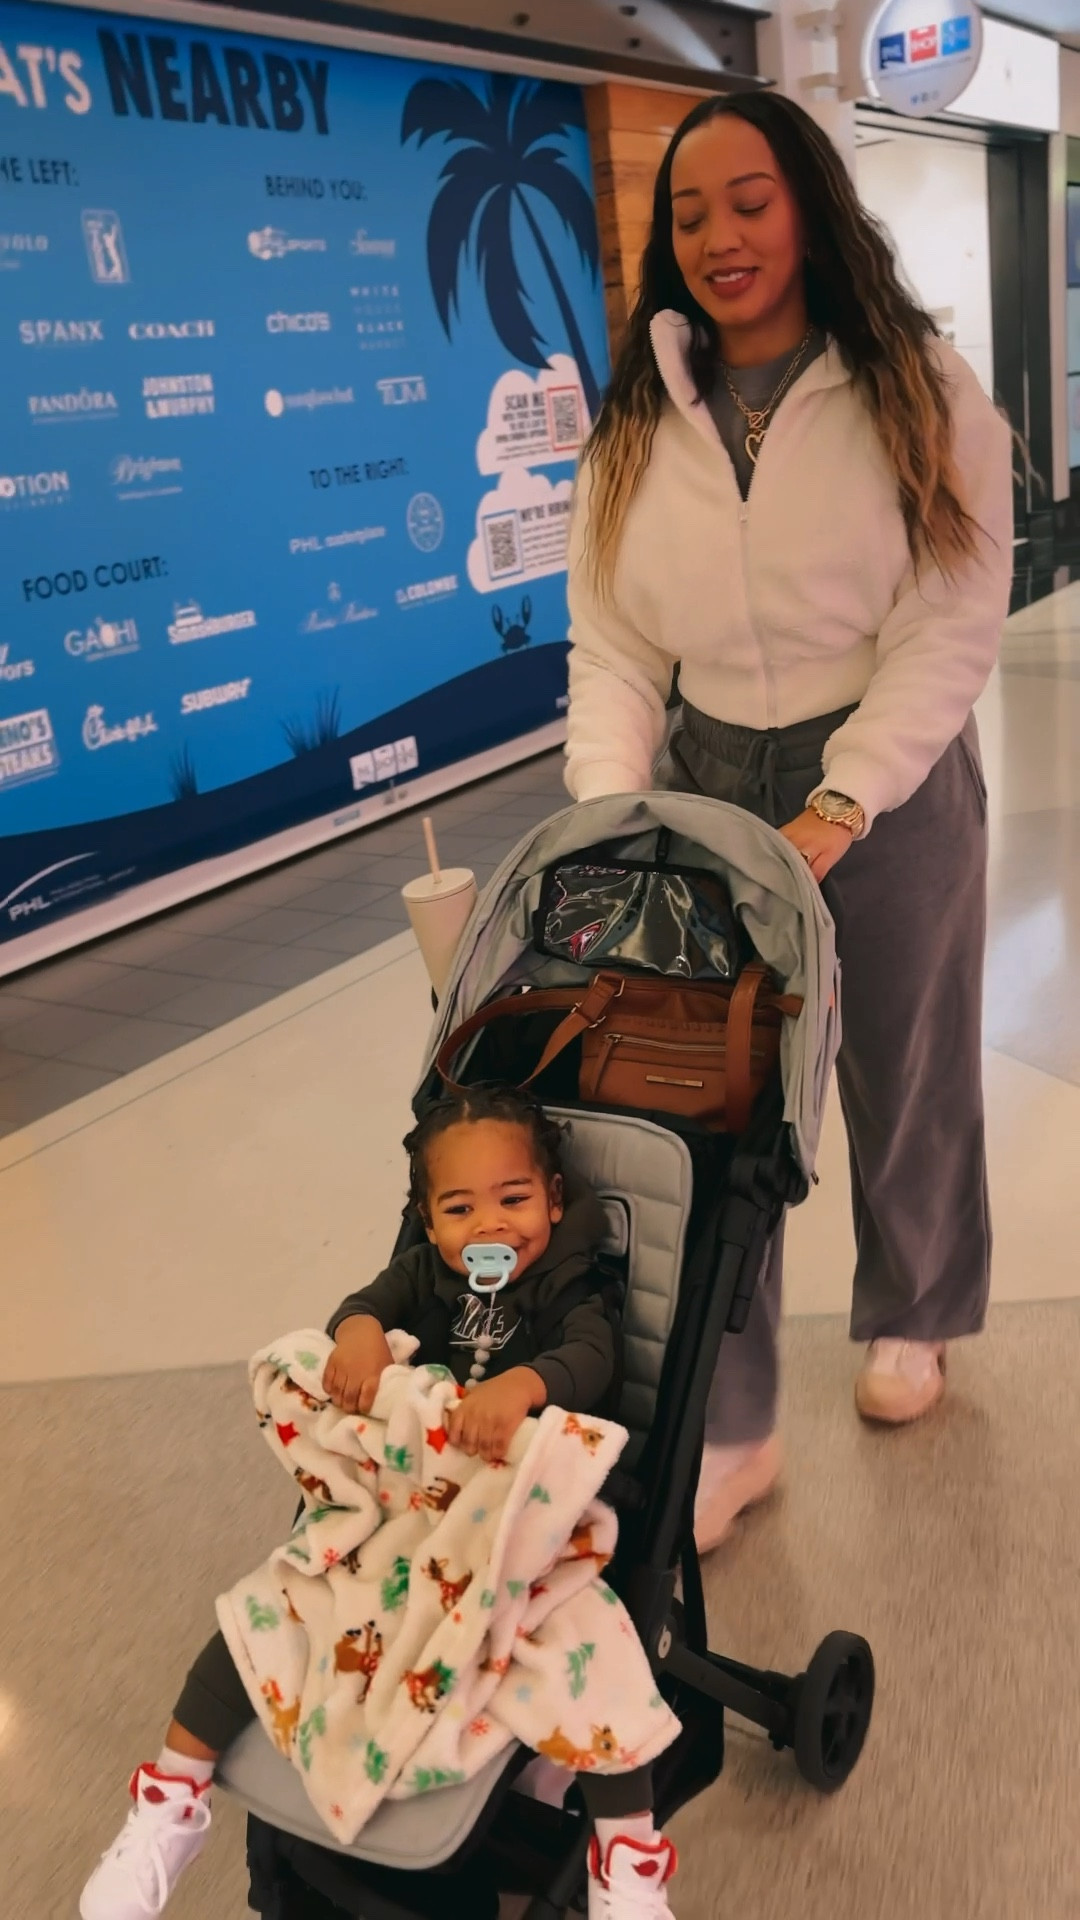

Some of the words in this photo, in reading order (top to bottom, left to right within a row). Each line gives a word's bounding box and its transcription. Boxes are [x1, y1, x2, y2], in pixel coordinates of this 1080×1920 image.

[97, 26, 330, 135] NEARBY
[265, 174, 324, 199] BEHIND
[20, 320, 103, 344] SPANX
[129, 320, 215, 339] COACH
[309, 469, 331, 489] TO
[334, 463, 360, 485] THE
[23, 570, 88, 602] FOOD
[94, 556, 169, 588] COURT:
[9, 895, 51, 921] PHL
